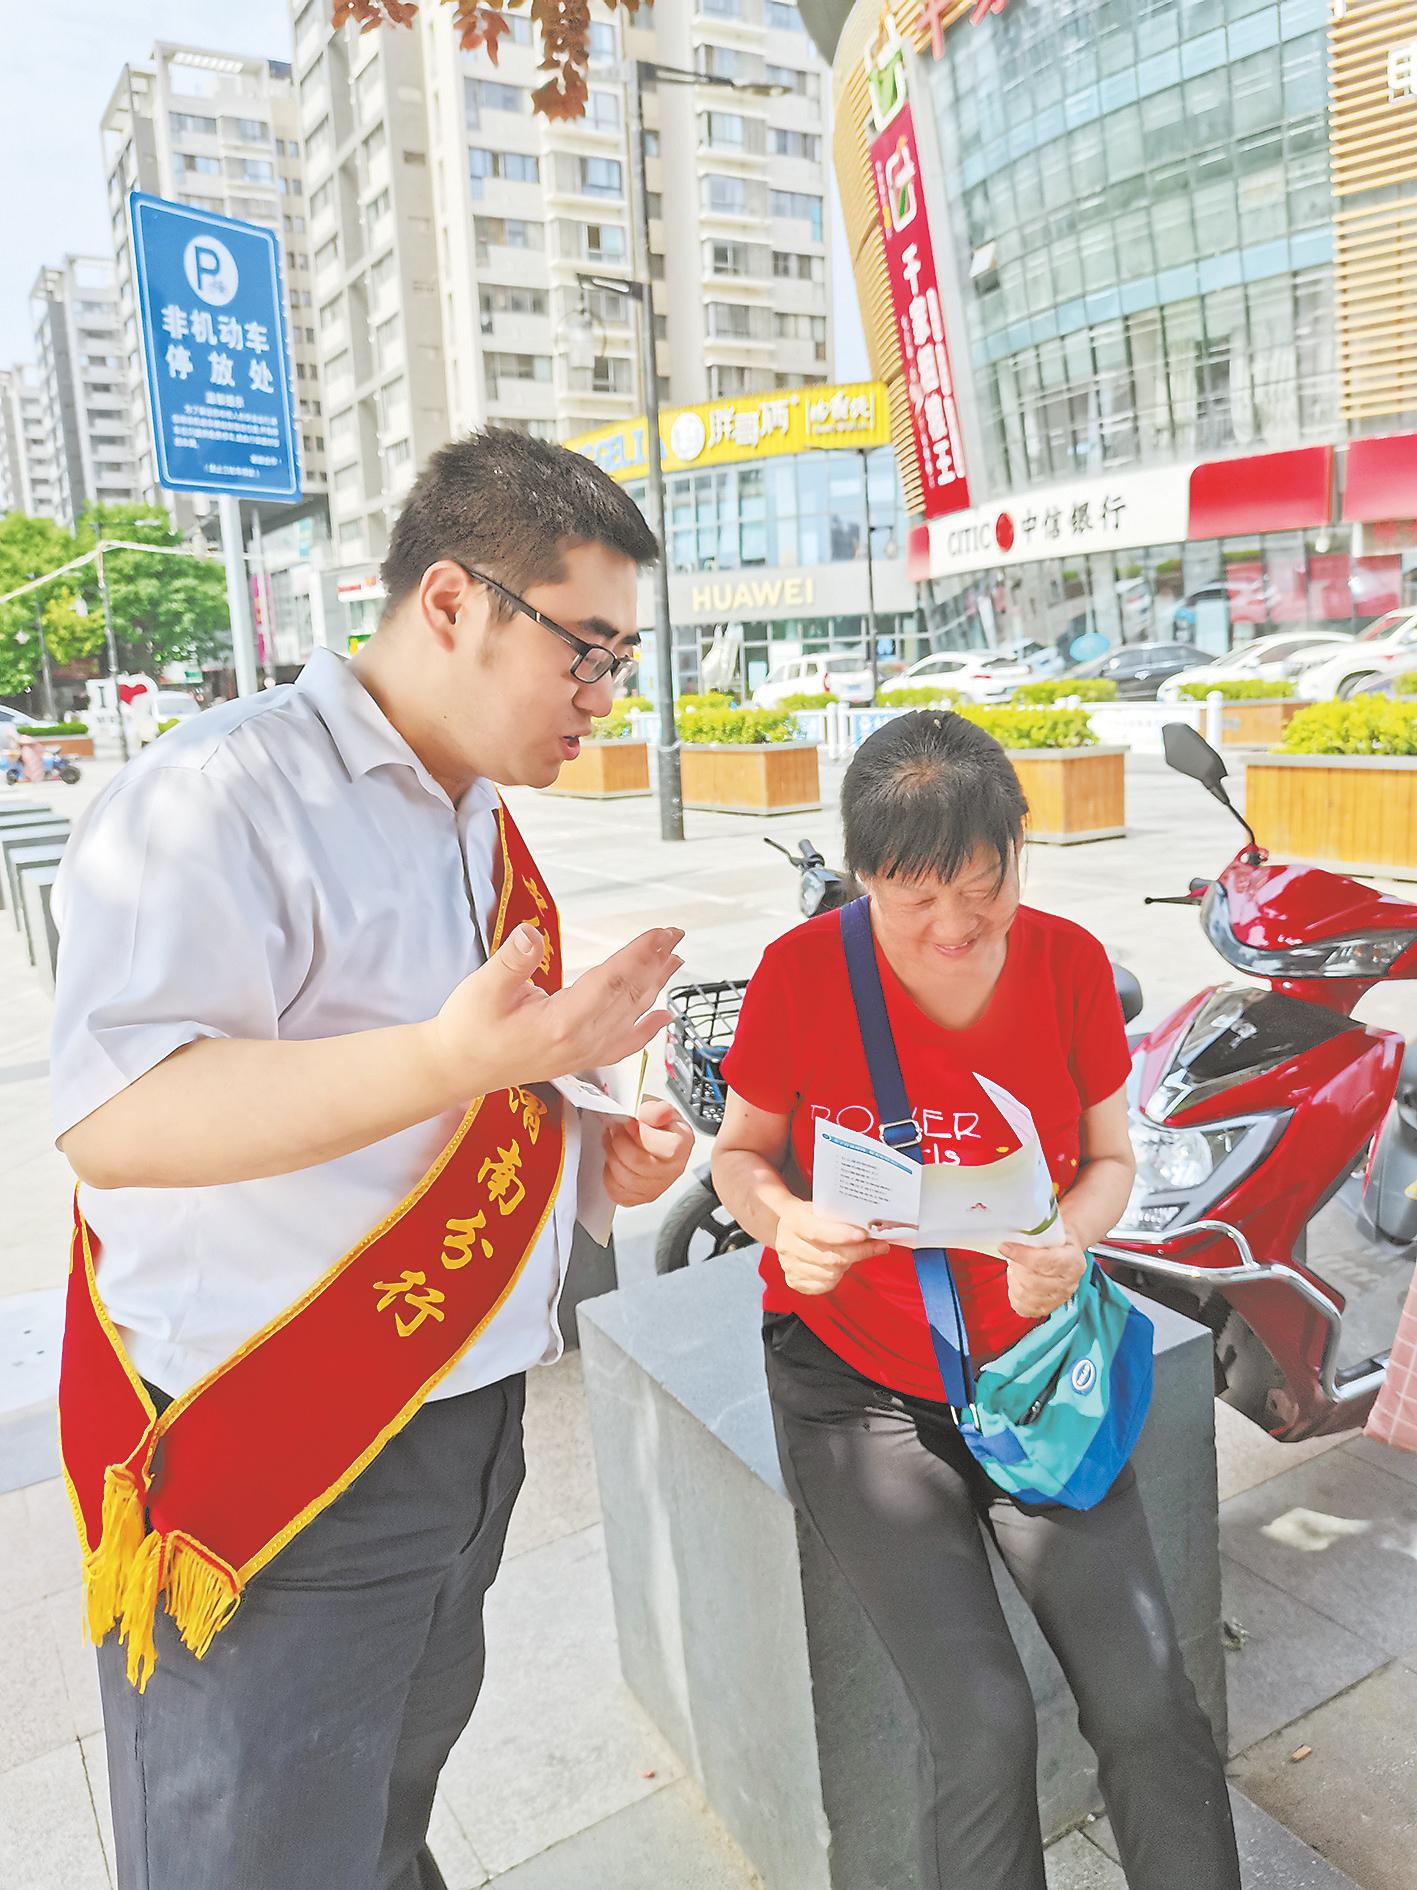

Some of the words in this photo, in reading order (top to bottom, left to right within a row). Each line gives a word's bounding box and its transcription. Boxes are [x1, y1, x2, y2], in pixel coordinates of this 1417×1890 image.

[161, 303, 270, 354] 非机动车
[948, 523, 991, 556] CITIC
[1021, 496, 1126, 543] 中信银行
[692, 578, 814, 612] HUAWEI
